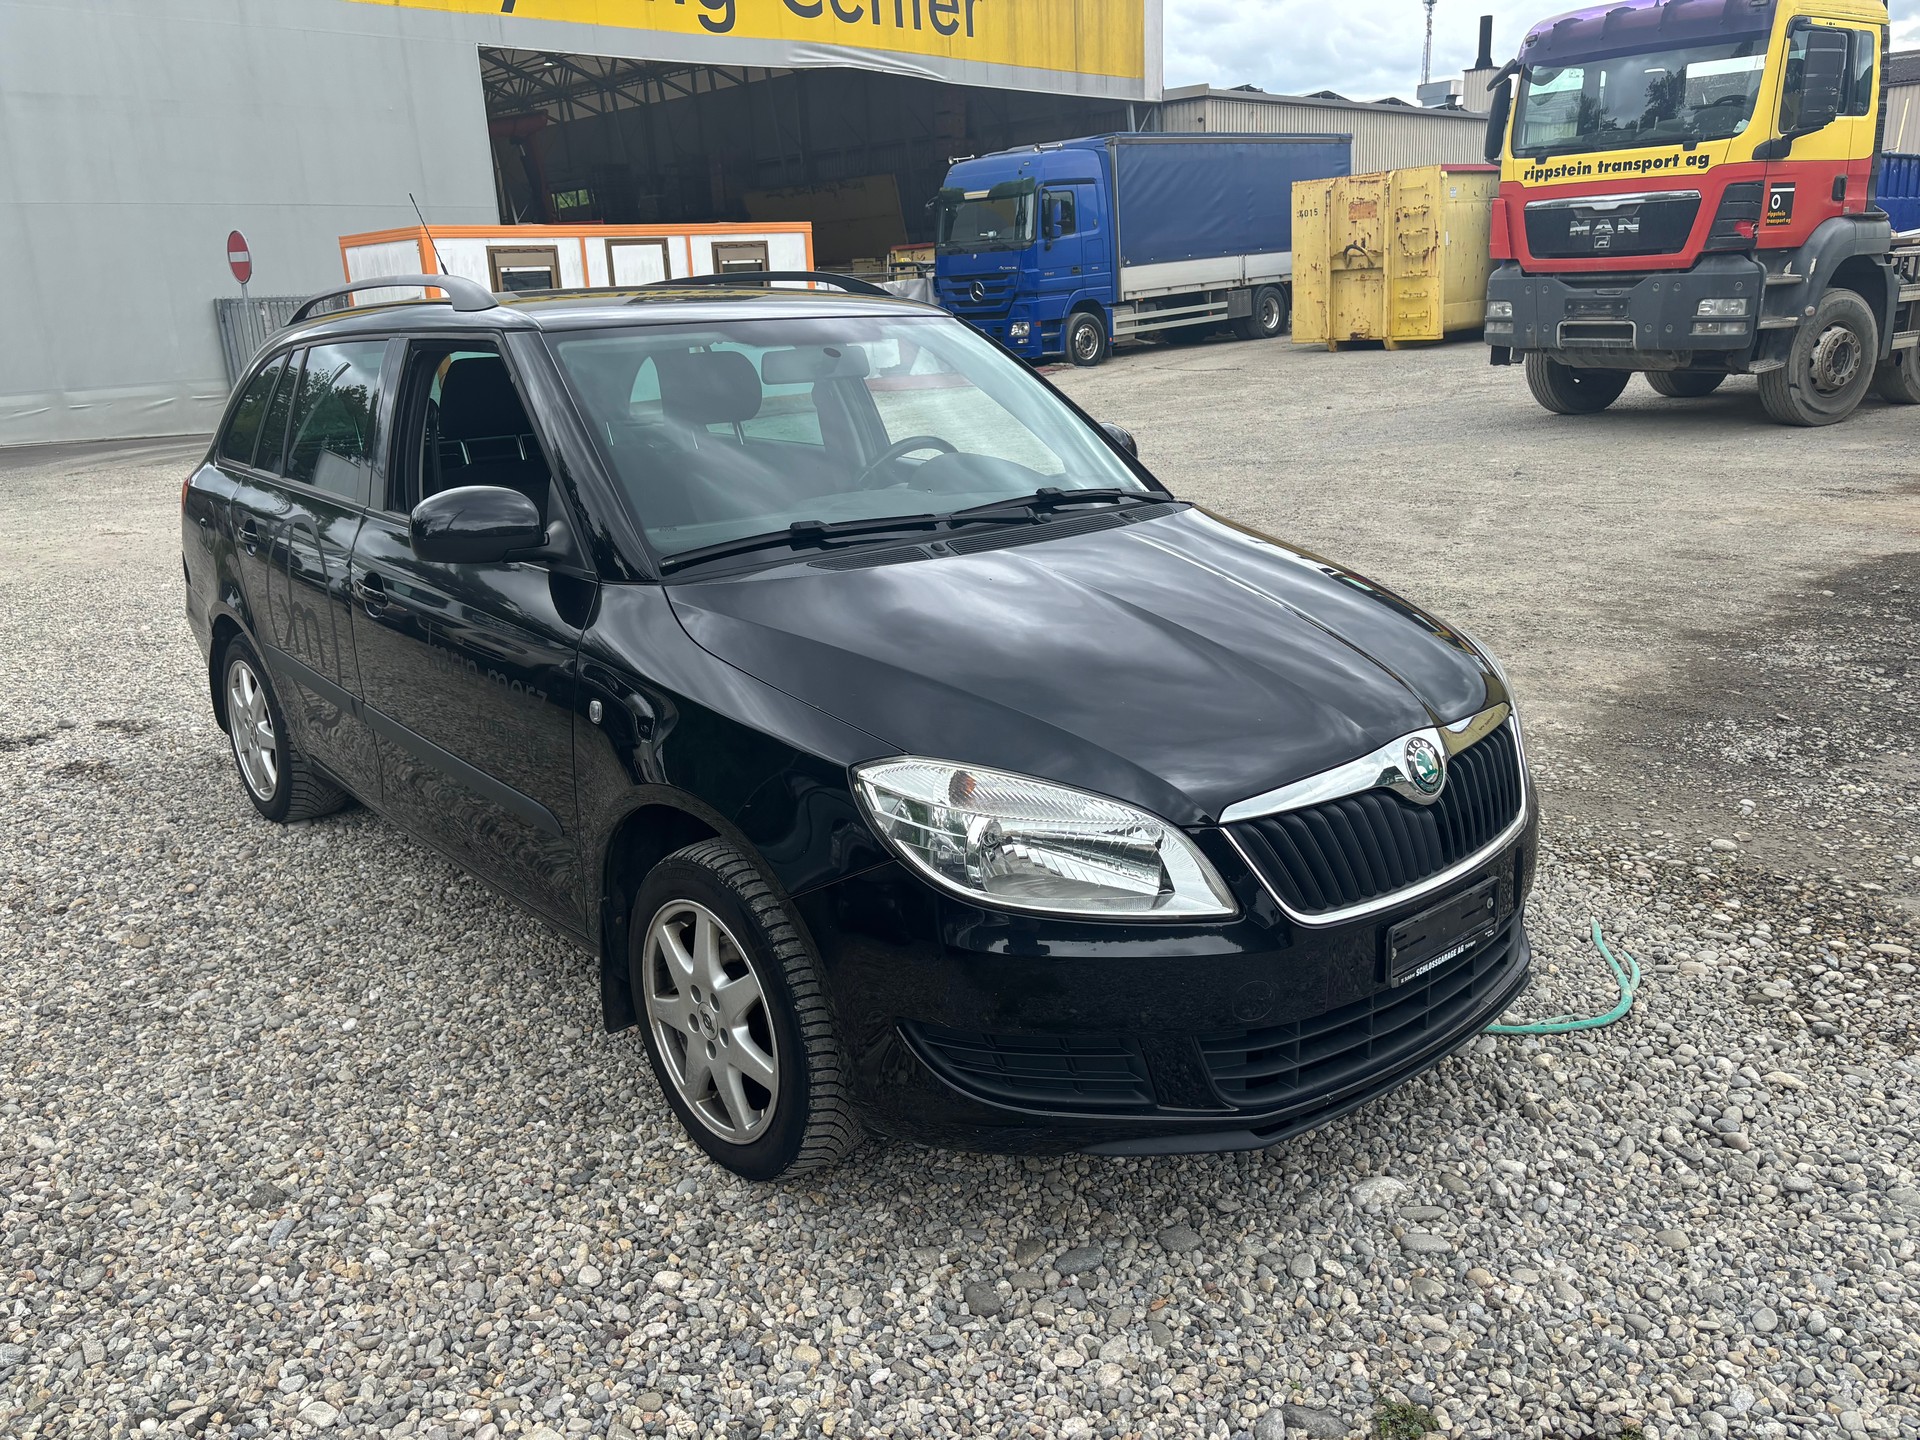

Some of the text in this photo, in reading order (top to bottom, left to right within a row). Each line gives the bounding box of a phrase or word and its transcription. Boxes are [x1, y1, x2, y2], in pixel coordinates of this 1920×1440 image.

[1523, 153, 1710, 183] rippstein transport ag
[1569, 217, 1640, 236] MAN
[1415, 948, 1457, 977] SCHLOSSGARAGE
[1457, 944, 1464, 955] AG
